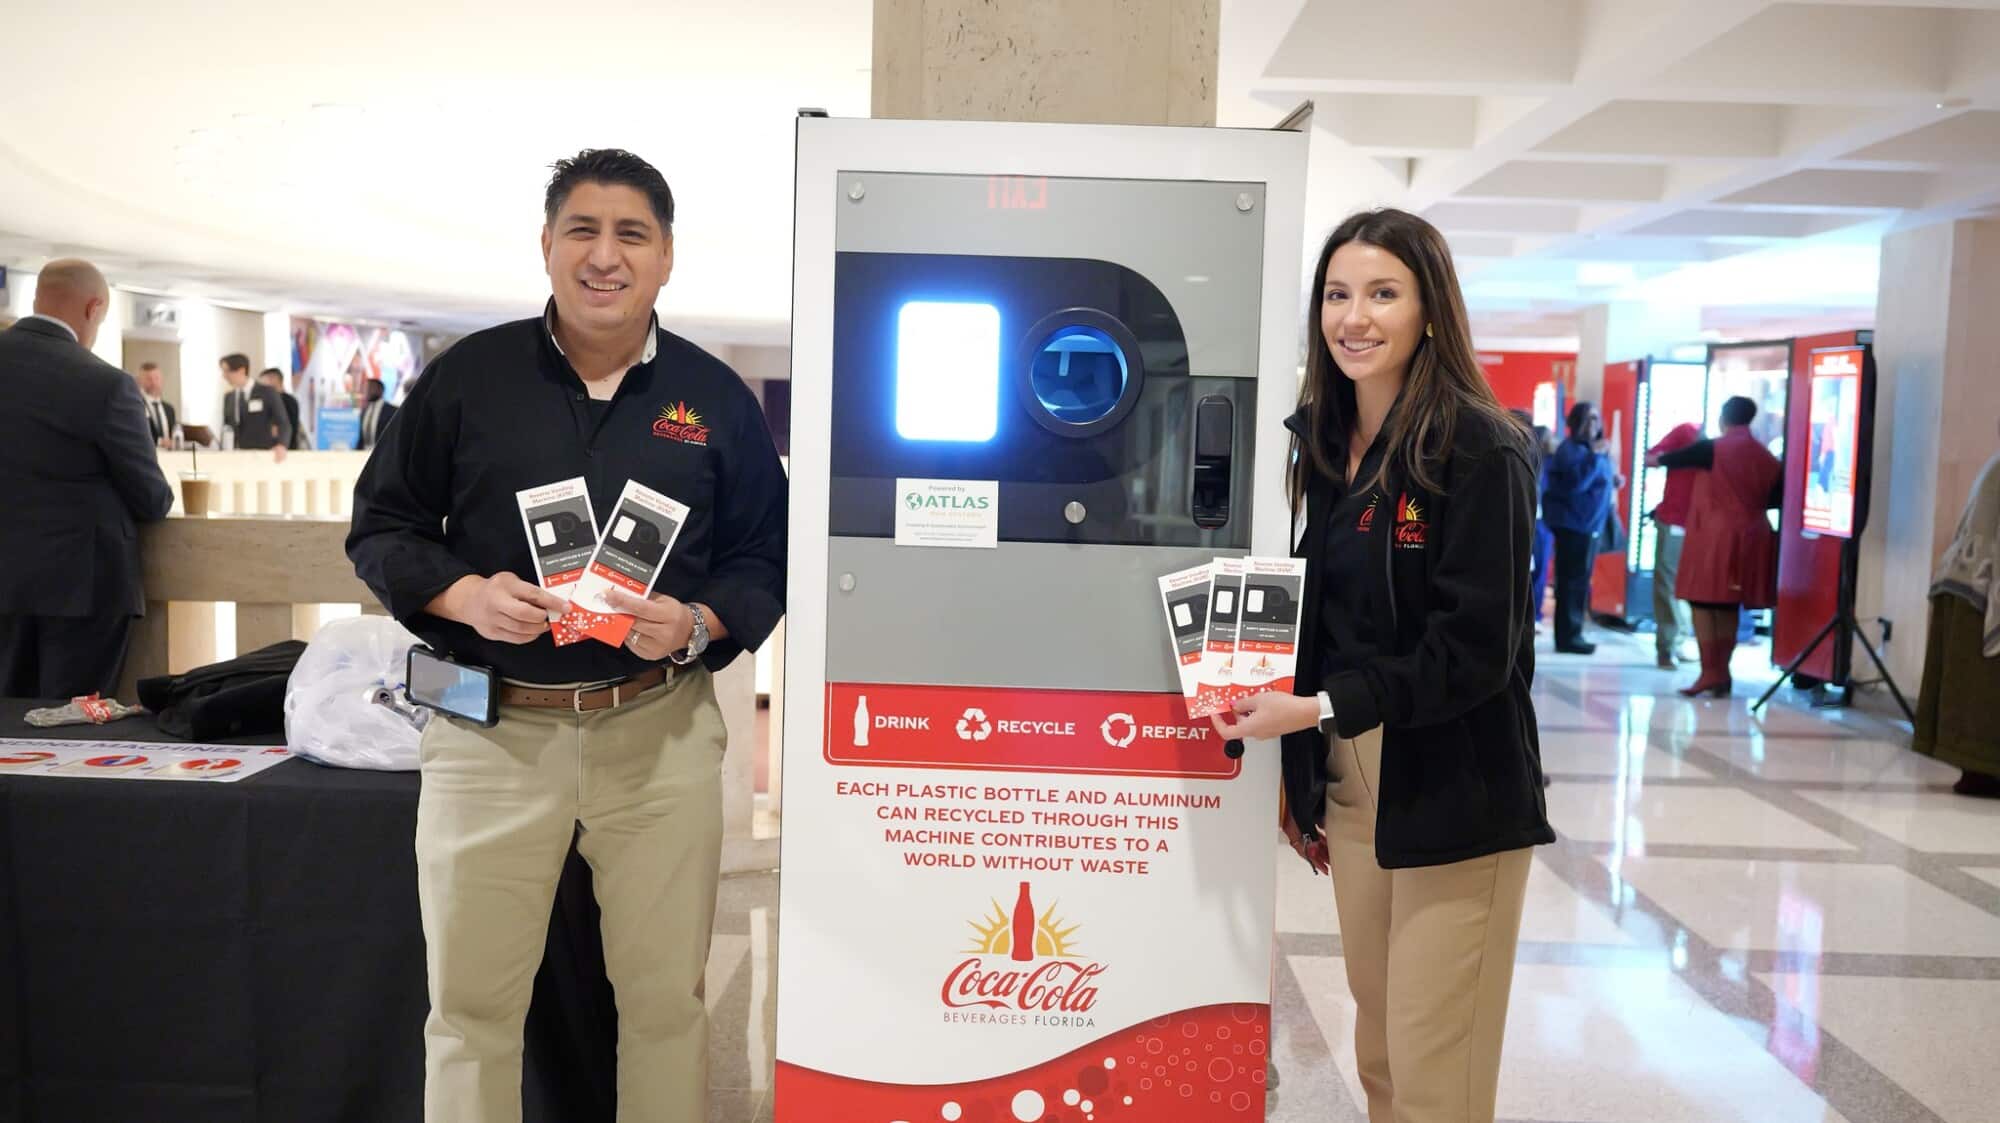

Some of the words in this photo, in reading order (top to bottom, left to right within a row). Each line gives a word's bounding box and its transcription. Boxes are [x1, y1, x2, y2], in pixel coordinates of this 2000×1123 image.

[925, 495, 990, 510] ATLAS
[875, 715, 929, 730] DRINK
[997, 719, 1076, 736] RECYCLE
[1142, 725, 1209, 740] REPEAT
[89, 743, 248, 753] MACHINES
[836, 781, 890, 797] EACH
[896, 783, 977, 800] PLASTIC
[984, 786, 1060, 803] BOTTLE
[1065, 790, 1108, 805] AND
[1114, 792, 1222, 809] ALUMINUM
[876, 806, 917, 821] CAN
[924, 807, 1025, 825] RECYCLED
[1032, 811, 1129, 829] THROUGH
[1135, 815, 1179, 831] THIS
[885, 828, 975, 846] MACHINE
[981, 832, 1118, 851] CONTRIBUTES
[1124, 837, 1151, 852] TO
[1155, 839, 1169, 853] A
[903, 852, 977, 869] WORLD
[982, 855, 1075, 872] WITHOUT
[1080, 858, 1149, 875] WASTE
[941, 957, 1110, 1013] Coca-Cola
[943, 1012, 1027, 1026] BEVERAGES
[1034, 1015, 1096, 1028] FLORIDA
